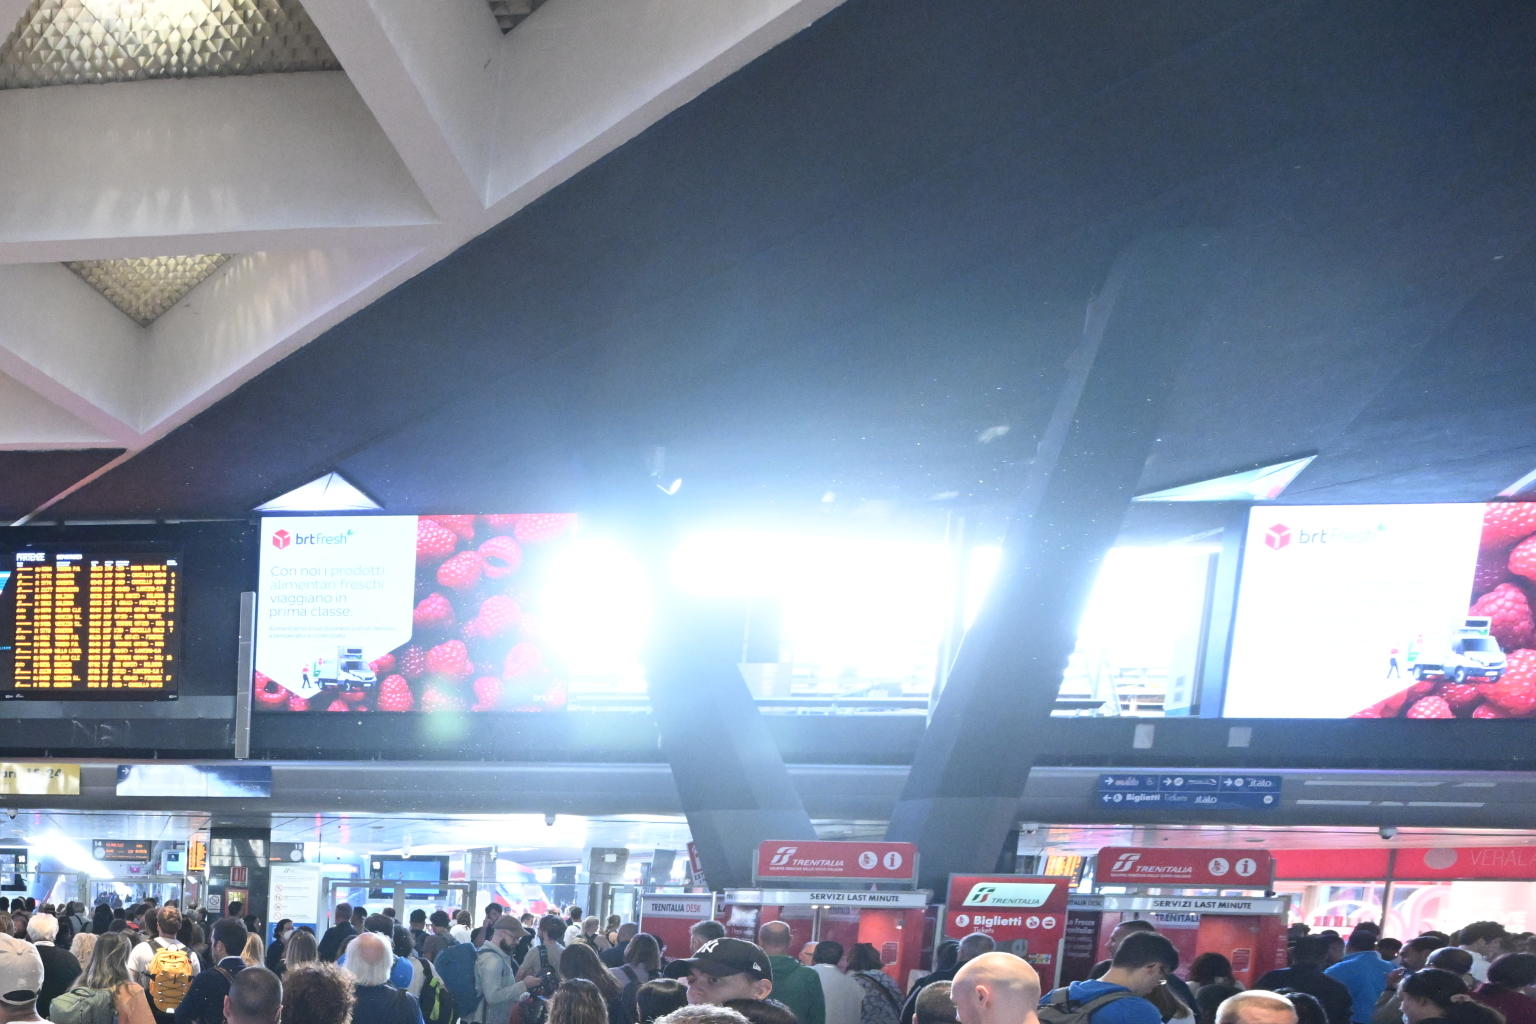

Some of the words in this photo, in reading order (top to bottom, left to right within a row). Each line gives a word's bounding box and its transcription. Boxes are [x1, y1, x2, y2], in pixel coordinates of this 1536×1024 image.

[270, 566, 297, 577] Con
[300, 566, 321, 577] noi
[330, 566, 385, 578] prodotti
[340, 579, 385, 591] freschi
[270, 593, 333, 606] viaggiano
[335, 593, 347, 604] in
[269, 607, 307, 620] prima
[310, 606, 353, 617] classe.
[1126, 793, 1160, 803] Biglietti
[792, 858, 844, 867] TRENITALIA
[1136, 864, 1193, 874] TRENITALIA
[810, 892, 845, 901] SERVIZI
[868, 894, 900, 902] MINUTE
[991, 896, 1041, 905] TRENITALIA
[651, 902, 684, 912] TRENITALIA
[685, 903, 701, 912] DESK
[1153, 899, 1192, 910] SERVIZI
[1196, 900, 1216, 909] LAST
[1217, 901, 1252, 910] MINUTE
[973, 915, 1022, 927] Biglietti
[1154, 913, 1200, 923] TRENITALI
